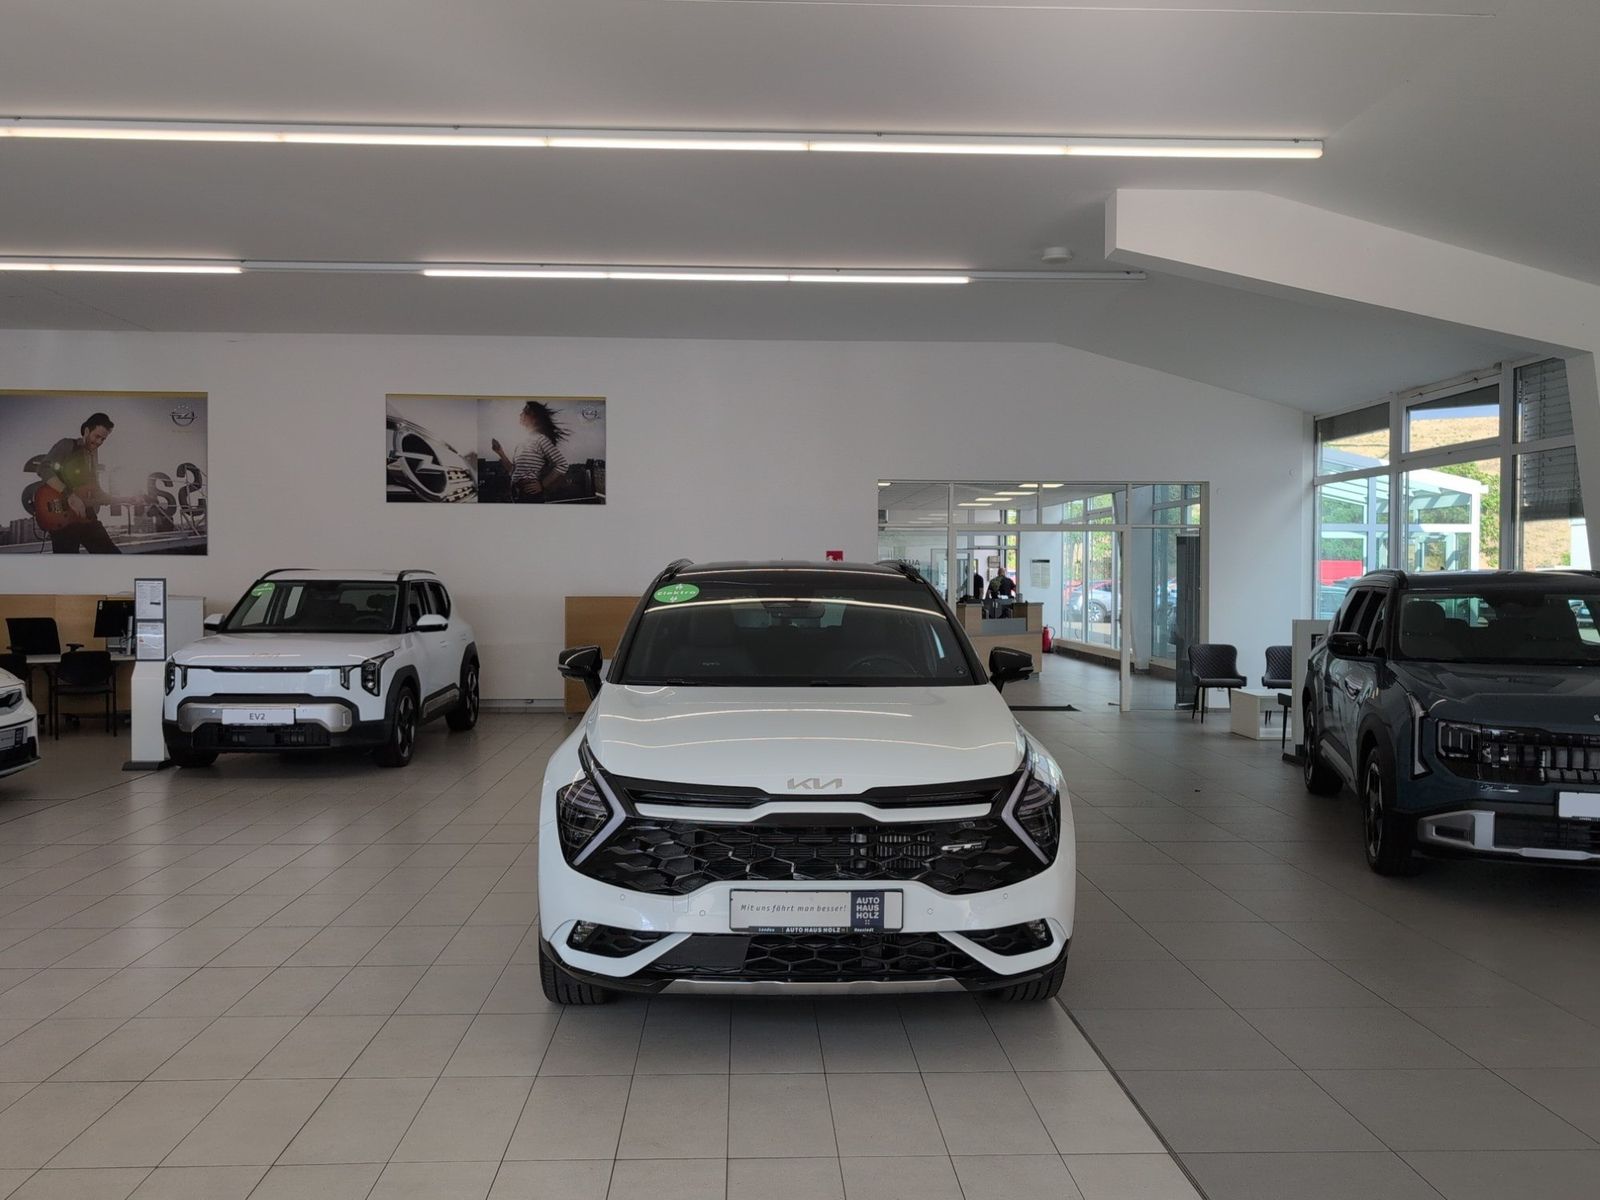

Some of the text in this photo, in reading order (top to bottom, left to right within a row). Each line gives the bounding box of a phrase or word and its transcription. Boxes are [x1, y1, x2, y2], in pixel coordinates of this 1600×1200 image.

[249, 713, 266, 721] EV2
[740, 904, 754, 912] Mit
[817, 904, 847, 912] besser!
[856, 904, 880, 912] HAUS
